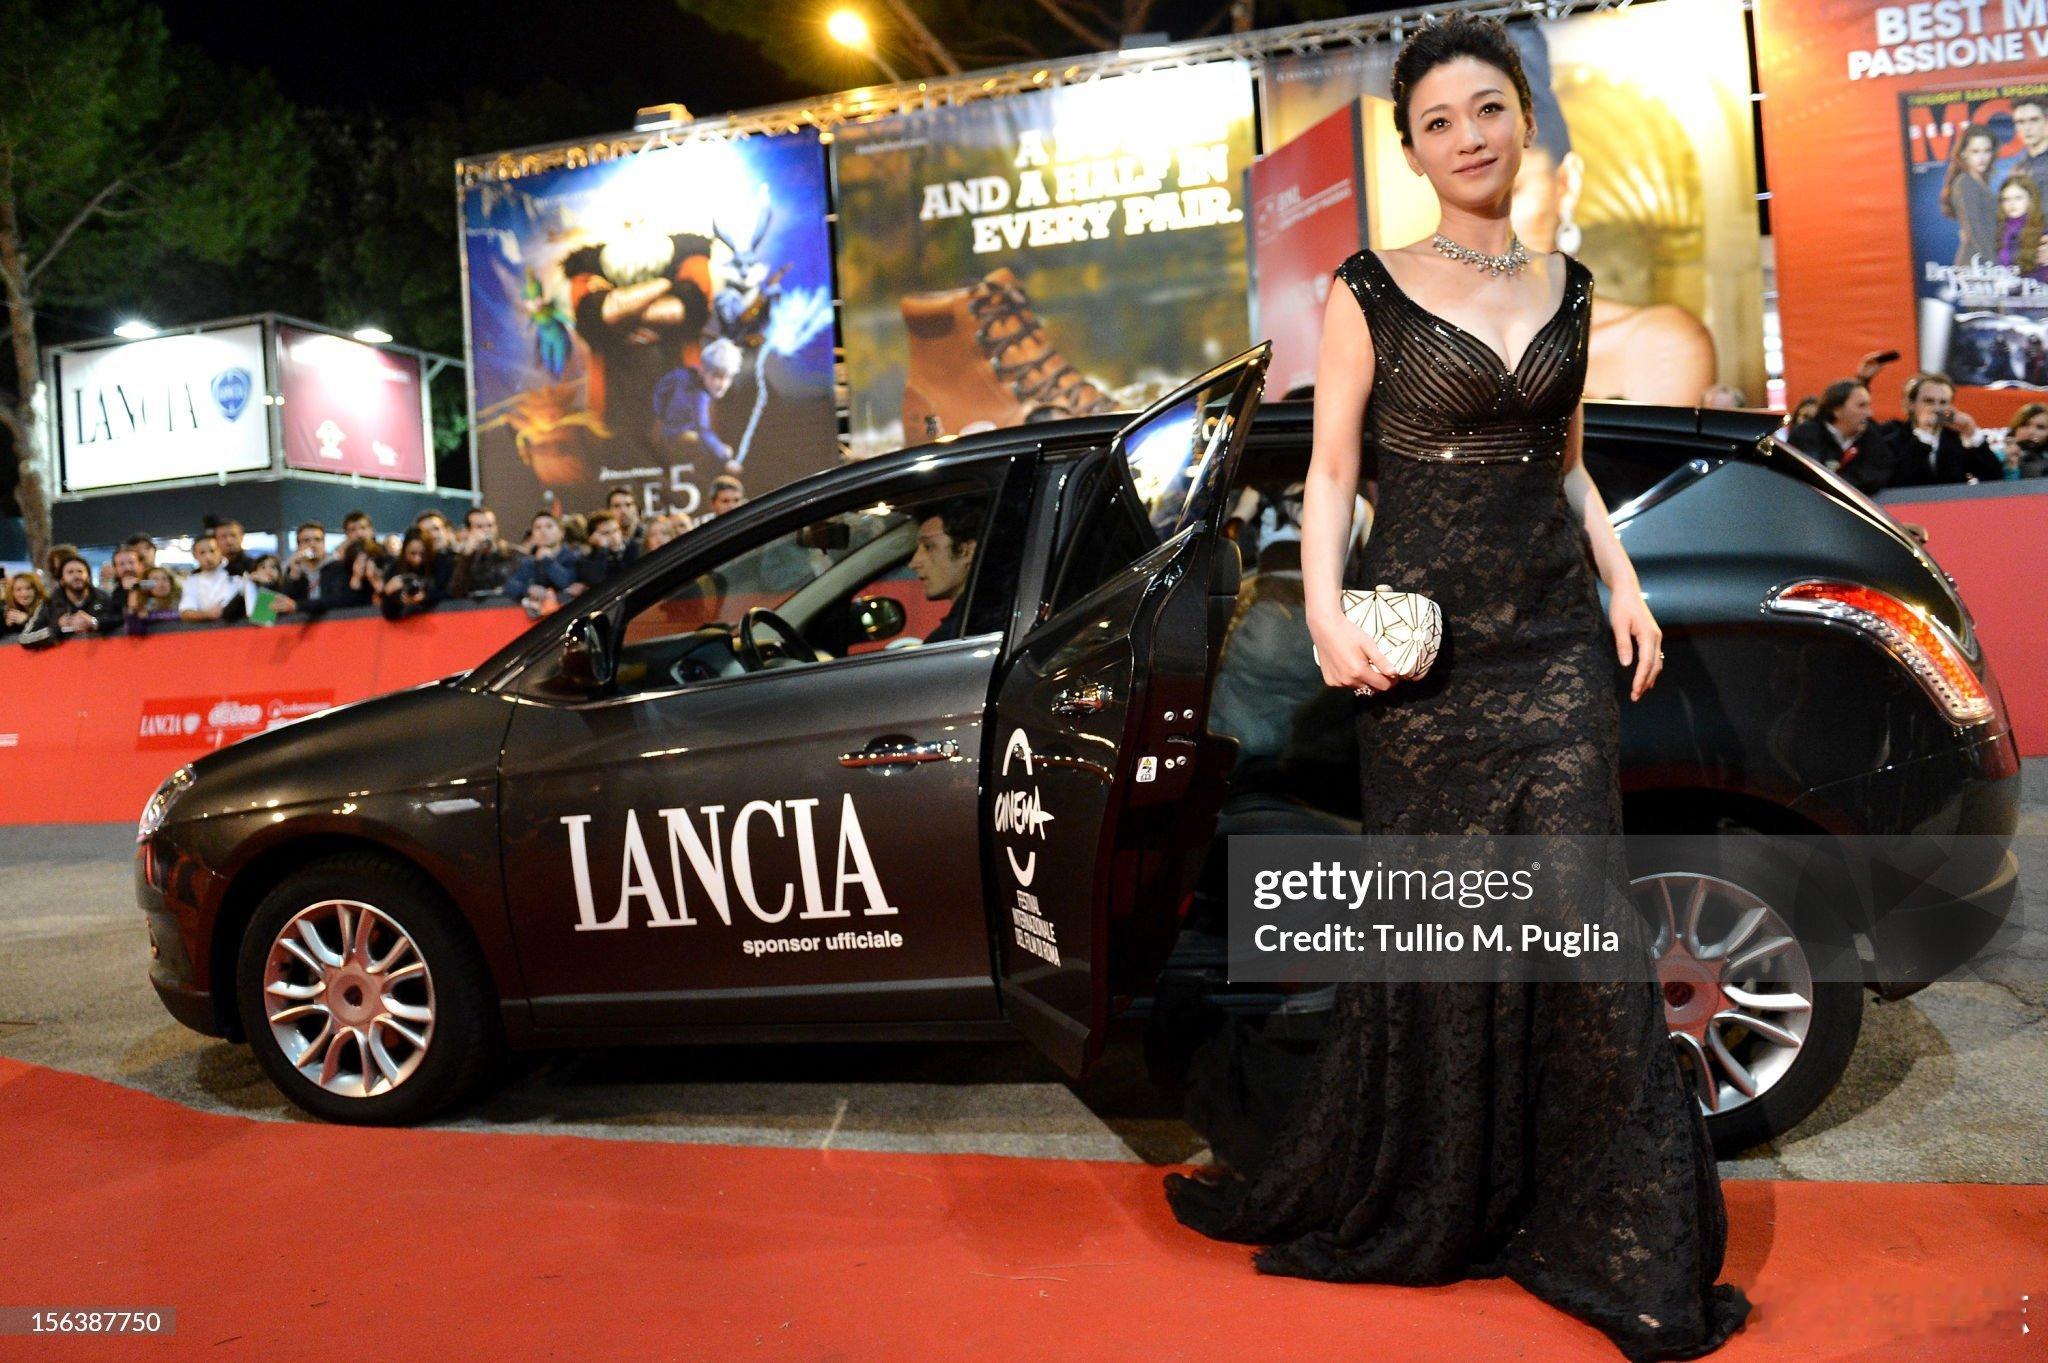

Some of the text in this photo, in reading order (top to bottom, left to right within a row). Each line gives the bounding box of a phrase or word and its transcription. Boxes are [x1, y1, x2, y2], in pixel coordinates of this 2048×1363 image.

[1875, 0, 1988, 46] BEST
[1847, 31, 2025, 80] PASSIONE
[920, 143, 1229, 221] AND A HALF IN
[972, 200, 1117, 254] EVERY
[1123, 186, 1243, 236] PAIR.
[75, 383, 198, 444] LANIA
[560, 792, 899, 932] LANCIA
[742, 930, 904, 958] sponsor ufficiale
